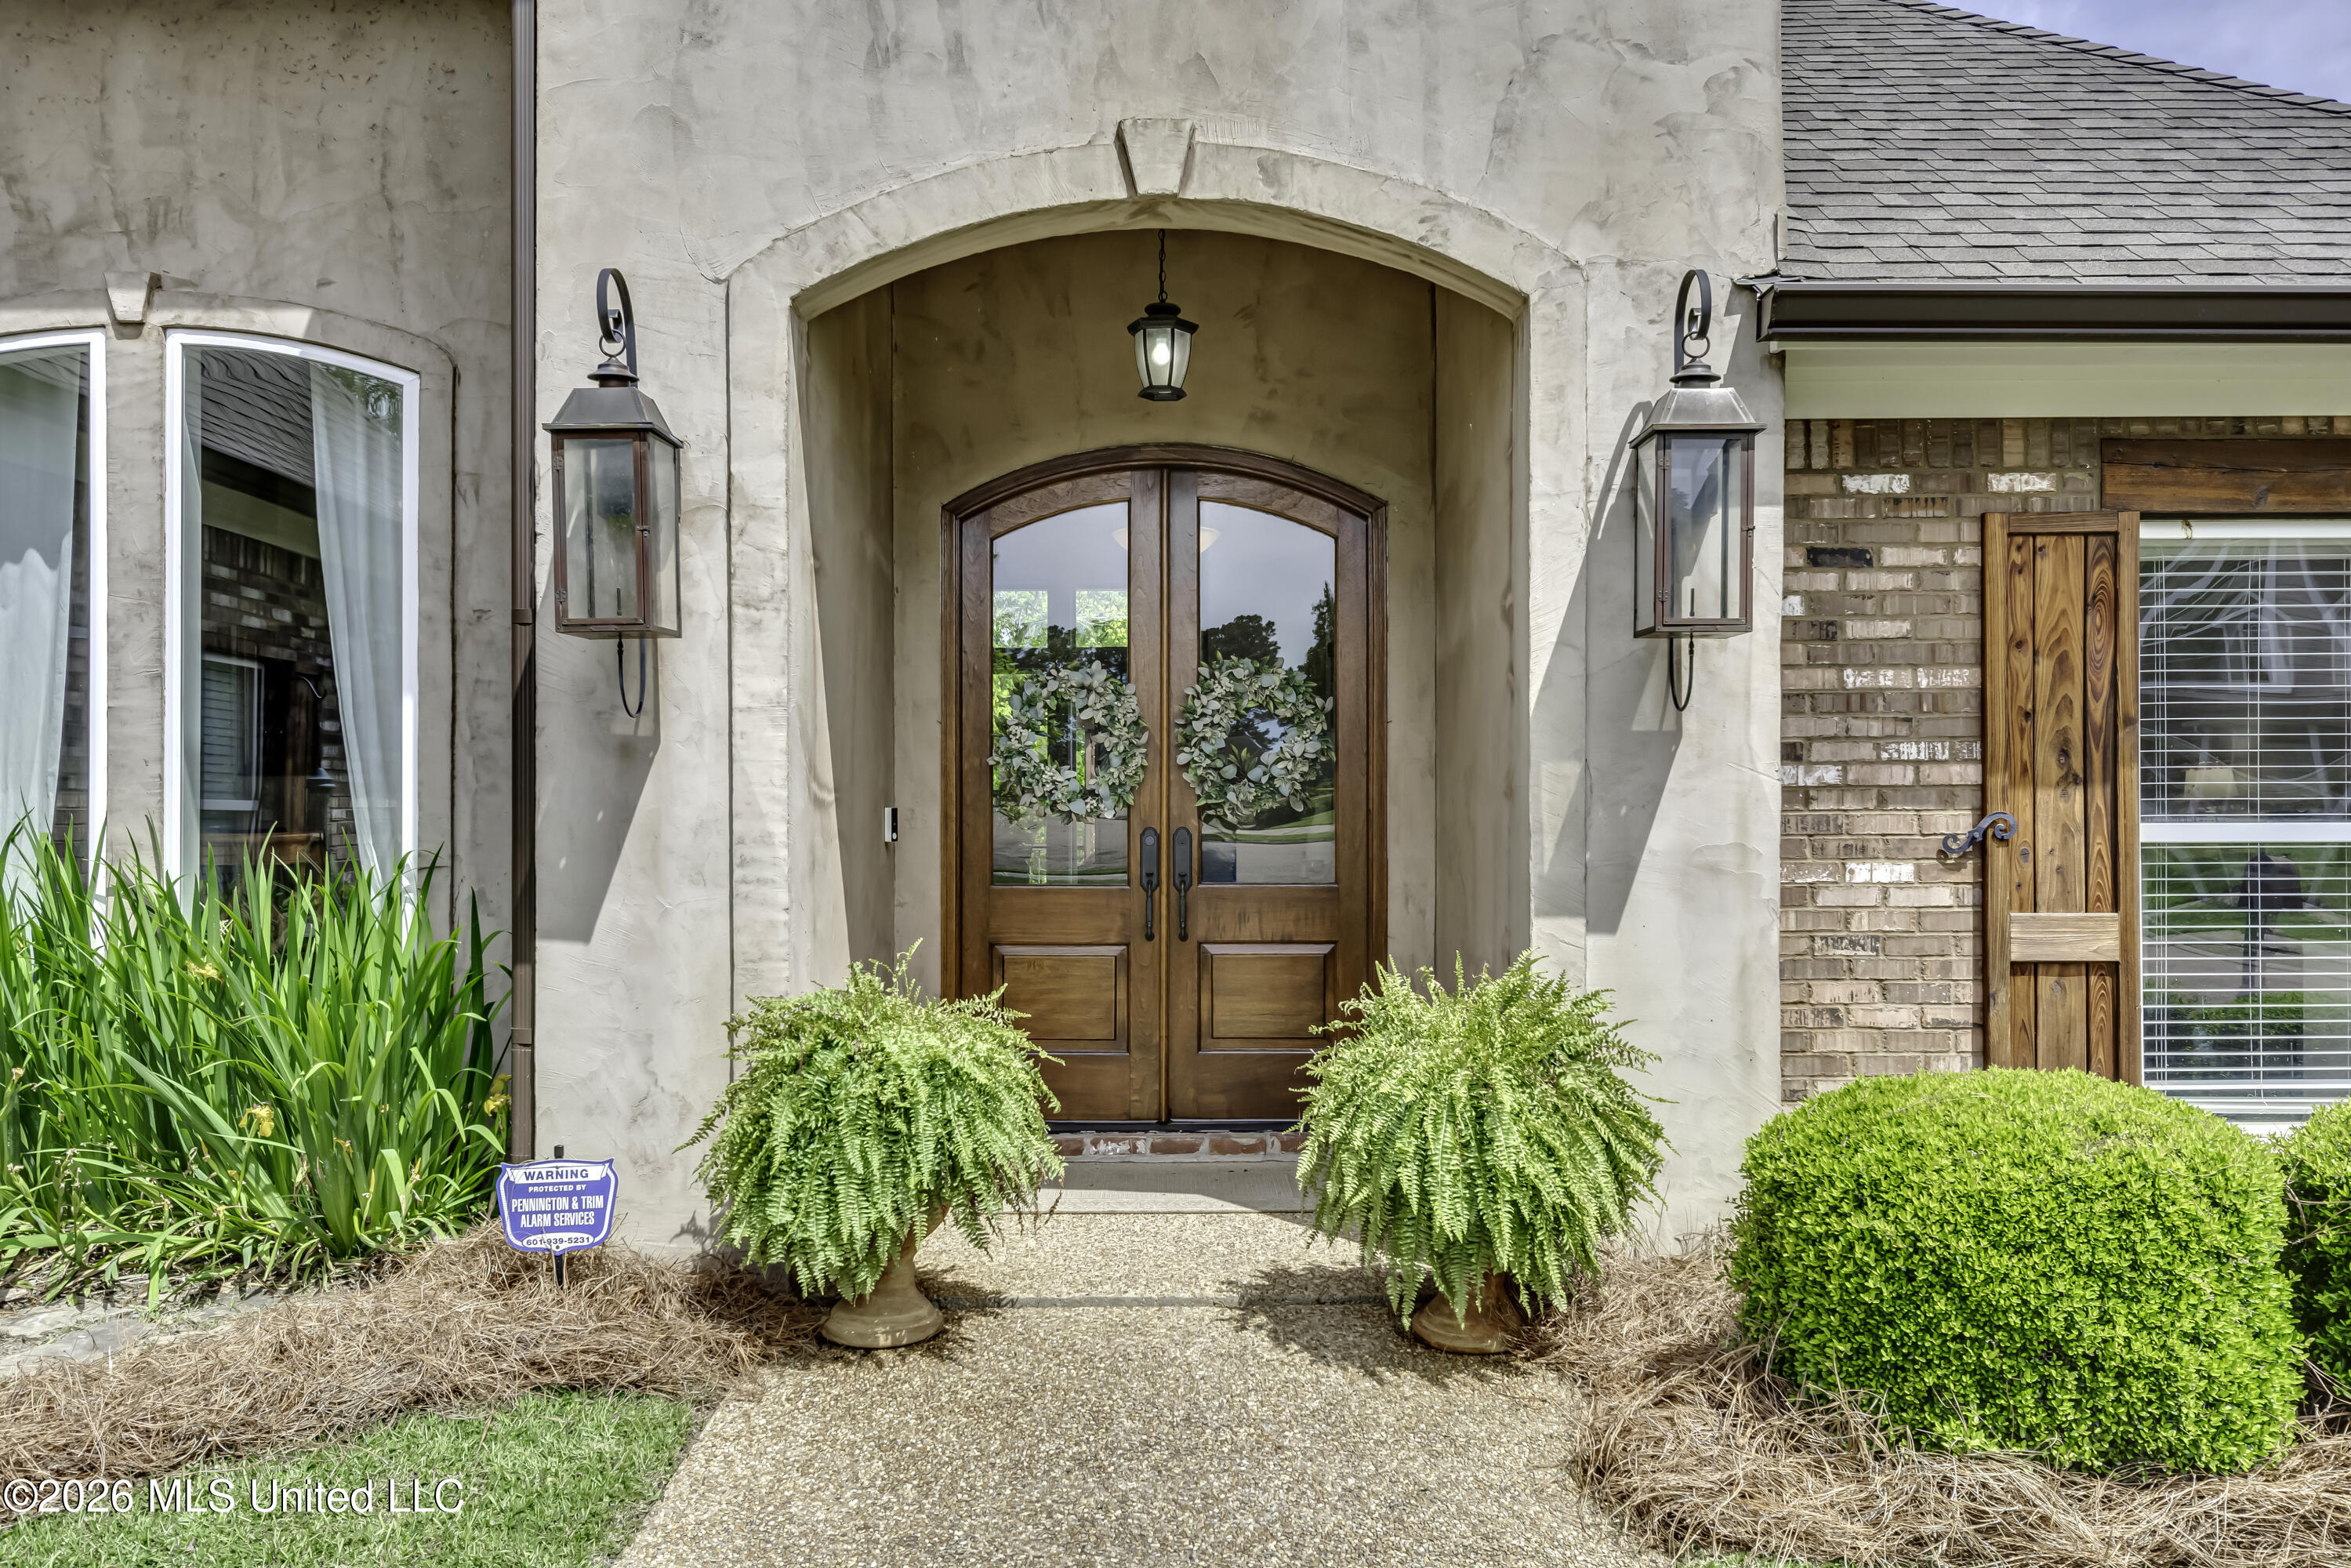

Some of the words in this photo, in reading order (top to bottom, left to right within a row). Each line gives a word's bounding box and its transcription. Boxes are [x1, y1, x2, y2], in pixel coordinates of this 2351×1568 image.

[524, 1169, 589, 1181] WARNING
[511, 1196, 569, 1213] PENNINGTON
[571, 1196, 579, 1210] &
[581, 1195, 604, 1209] TRIM
[521, 1214, 551, 1228] ALARM
[553, 1211, 595, 1226] SERVICES
[526, 1236, 590, 1246] 601-939-5231
